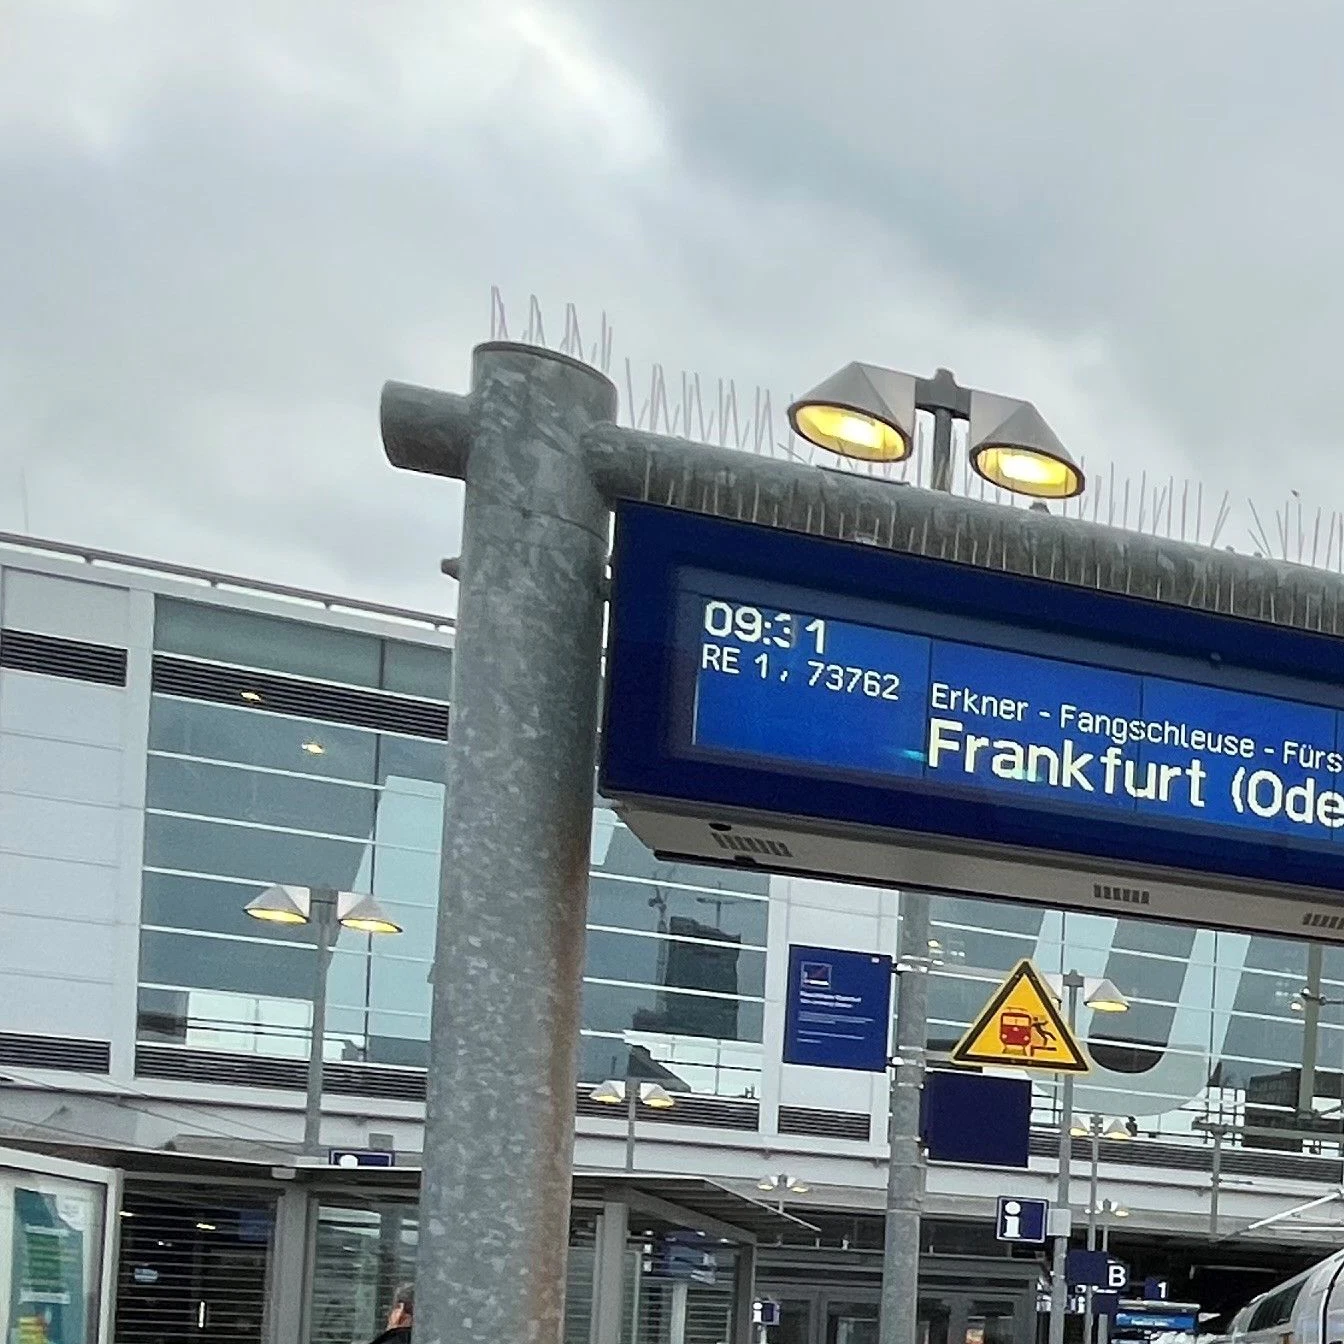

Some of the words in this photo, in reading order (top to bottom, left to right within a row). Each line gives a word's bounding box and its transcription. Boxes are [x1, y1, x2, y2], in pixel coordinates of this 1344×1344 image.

[703, 600, 826, 654] 09:31
[701, 643, 741, 675] RE
[754, 652, 769, 679] 1
[806, 660, 900, 700] 73762
[931, 682, 1029, 721] Erkner
[1060, 704, 1255, 758] Fangschleuse
[928, 717, 1206, 808] Frankfurt
[1108, 1265, 1127, 1287] B
[1156, 1281, 1168, 1299] 1
